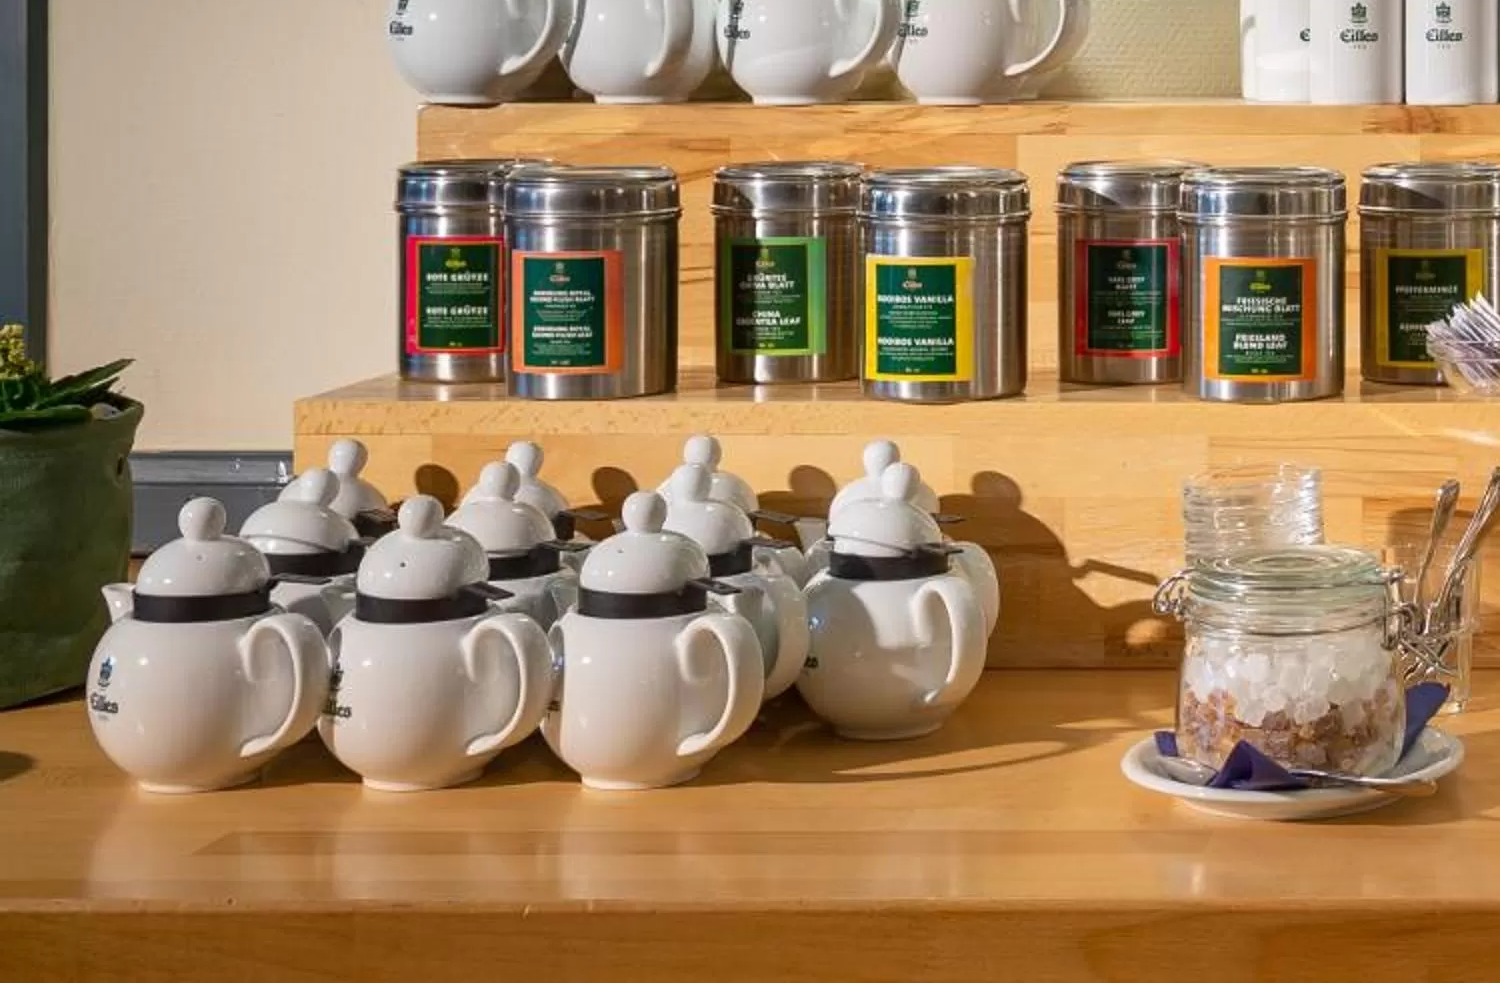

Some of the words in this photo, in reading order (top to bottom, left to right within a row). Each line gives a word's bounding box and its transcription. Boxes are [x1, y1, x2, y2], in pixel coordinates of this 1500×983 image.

[1340, 28, 1379, 43] Eilles
[1425, 28, 1463, 43] Eilles
[914, 294, 953, 304] VANILLA
[752, 310, 780, 318] CHINA
[914, 336, 954, 346] VANILLA
[322, 700, 352, 718] illes
